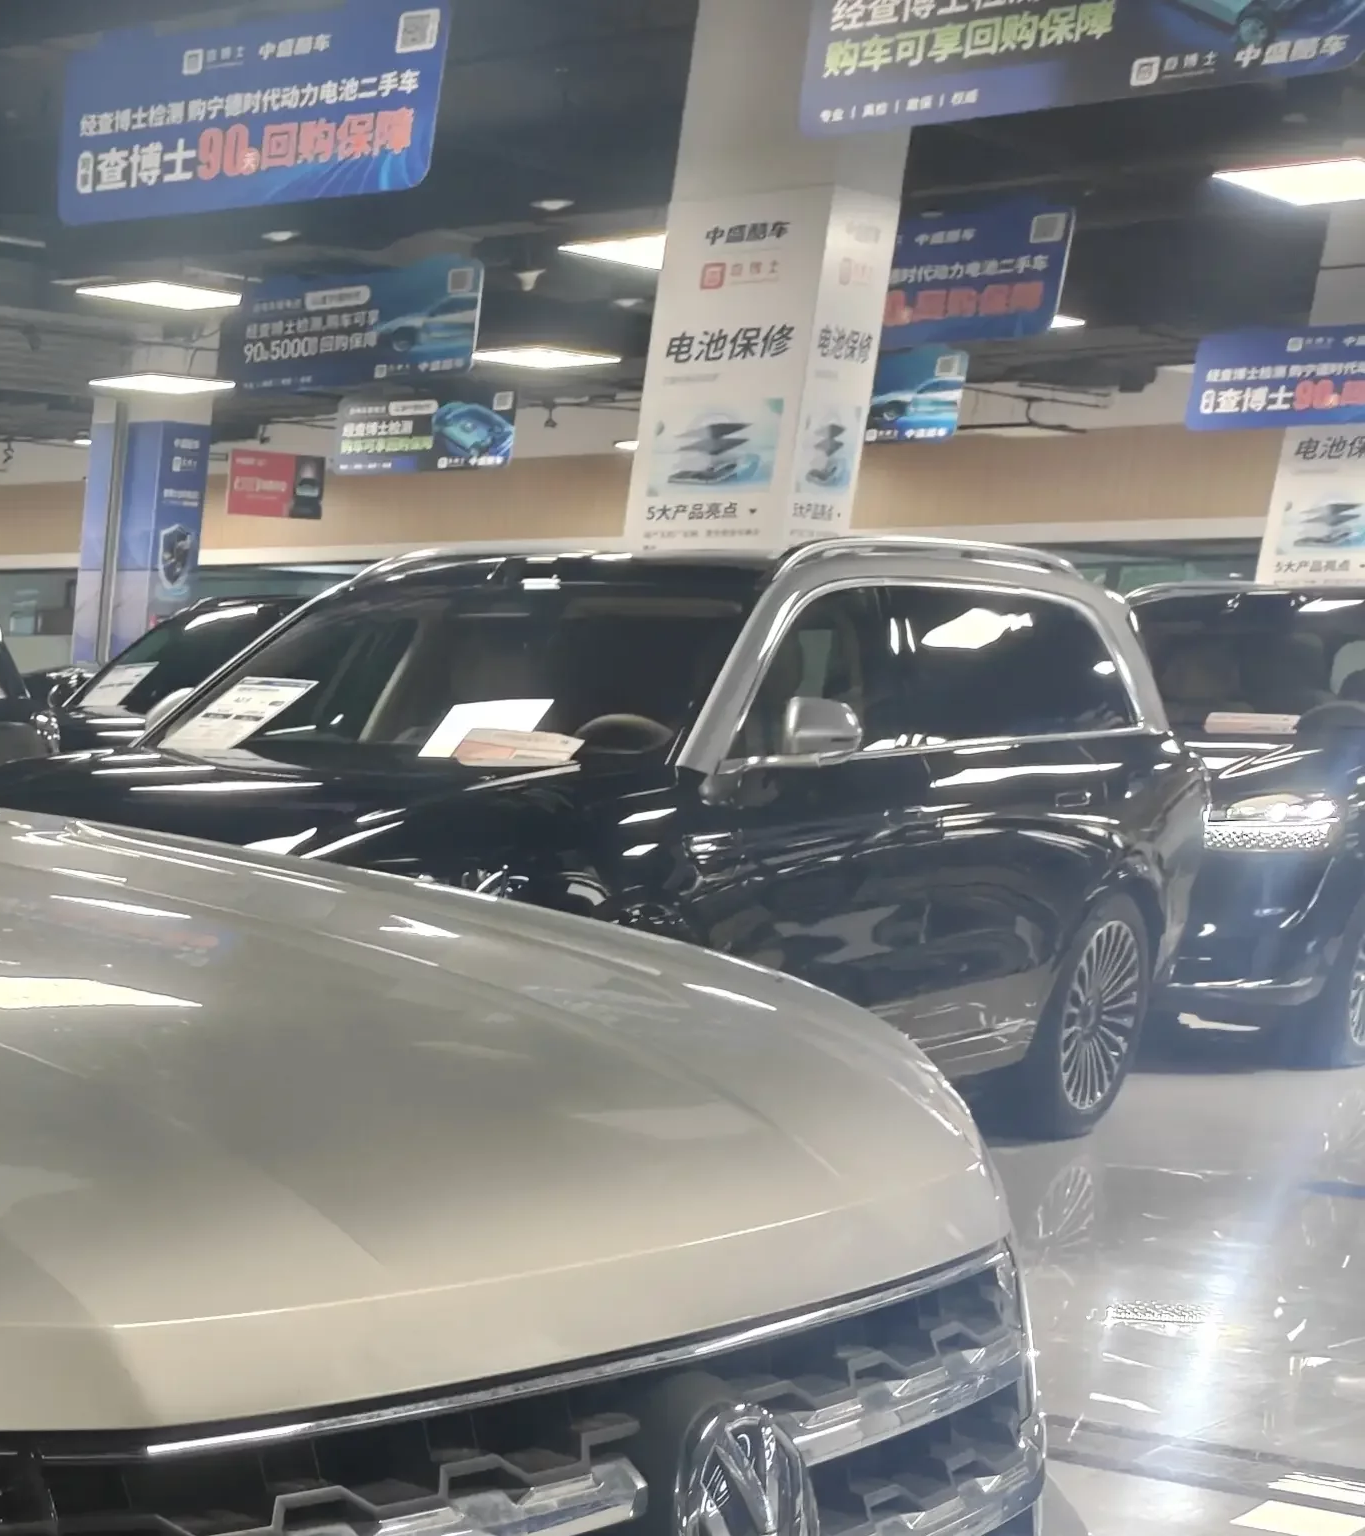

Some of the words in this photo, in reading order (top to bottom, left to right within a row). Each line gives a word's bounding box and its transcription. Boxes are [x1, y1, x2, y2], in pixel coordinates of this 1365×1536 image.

[822, 2, 1116, 78] 购车可享回购保障
[665, 324, 795, 364] 电池保修
[646, 502, 737, 521] 5大产品亮点
